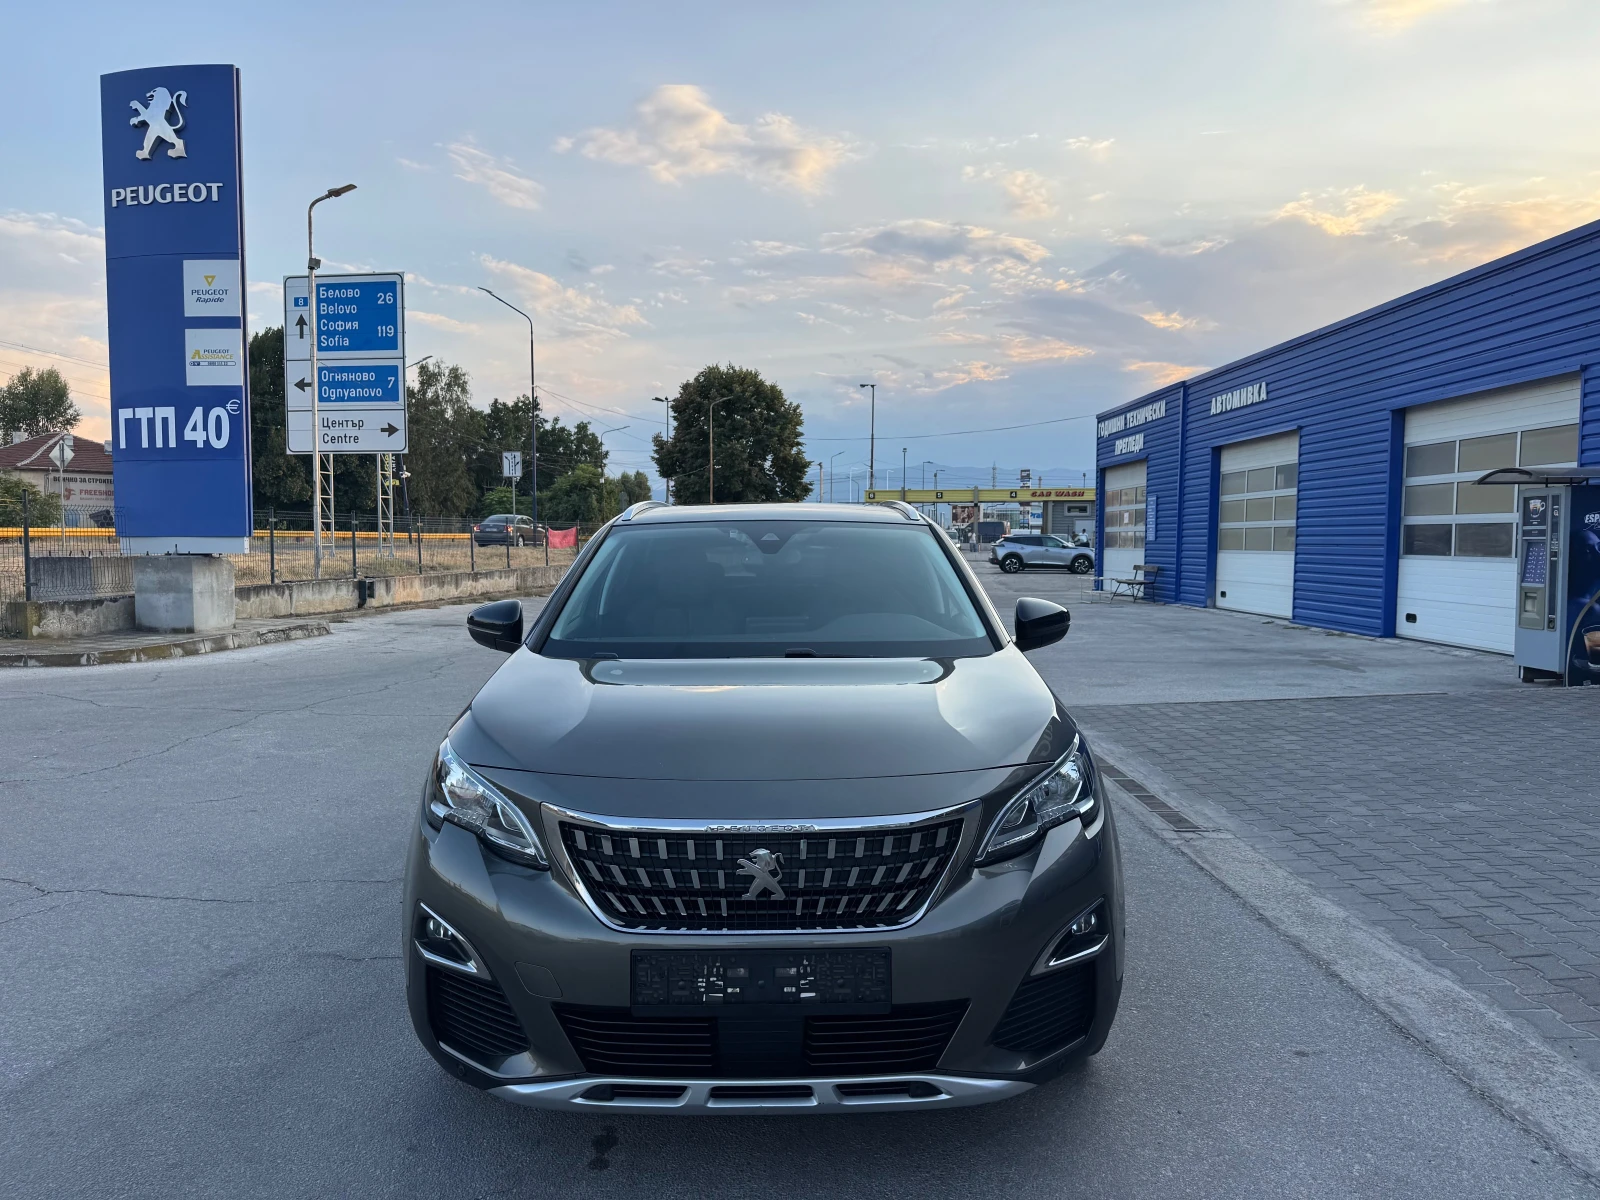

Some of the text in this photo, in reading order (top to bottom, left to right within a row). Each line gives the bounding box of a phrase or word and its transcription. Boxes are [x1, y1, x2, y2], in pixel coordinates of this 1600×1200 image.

[110, 181, 223, 207] PEUGEOT
[298, 298, 304, 306] 8
[319, 287, 394, 305] Белово 26
[320, 303, 357, 315] Belovo
[320, 319, 394, 338] София 119
[320, 336, 349, 347] Sofia
[321, 370, 395, 389] Огняново 7
[321, 386, 382, 401] Ognyanovo
[1210, 381, 1268, 416] АВТОМИВКА
[118, 406, 177, 449] ГТП
[322, 417, 364, 430] Център
[1098, 400, 1166, 438] ГОДИШНИ ТЕХНИЧЕСКИ
[322, 433, 360, 445] Centre
[1114, 433, 1144, 456] ПРЕГЛЕДИ
[1585, 513, 1600, 523] ESP
